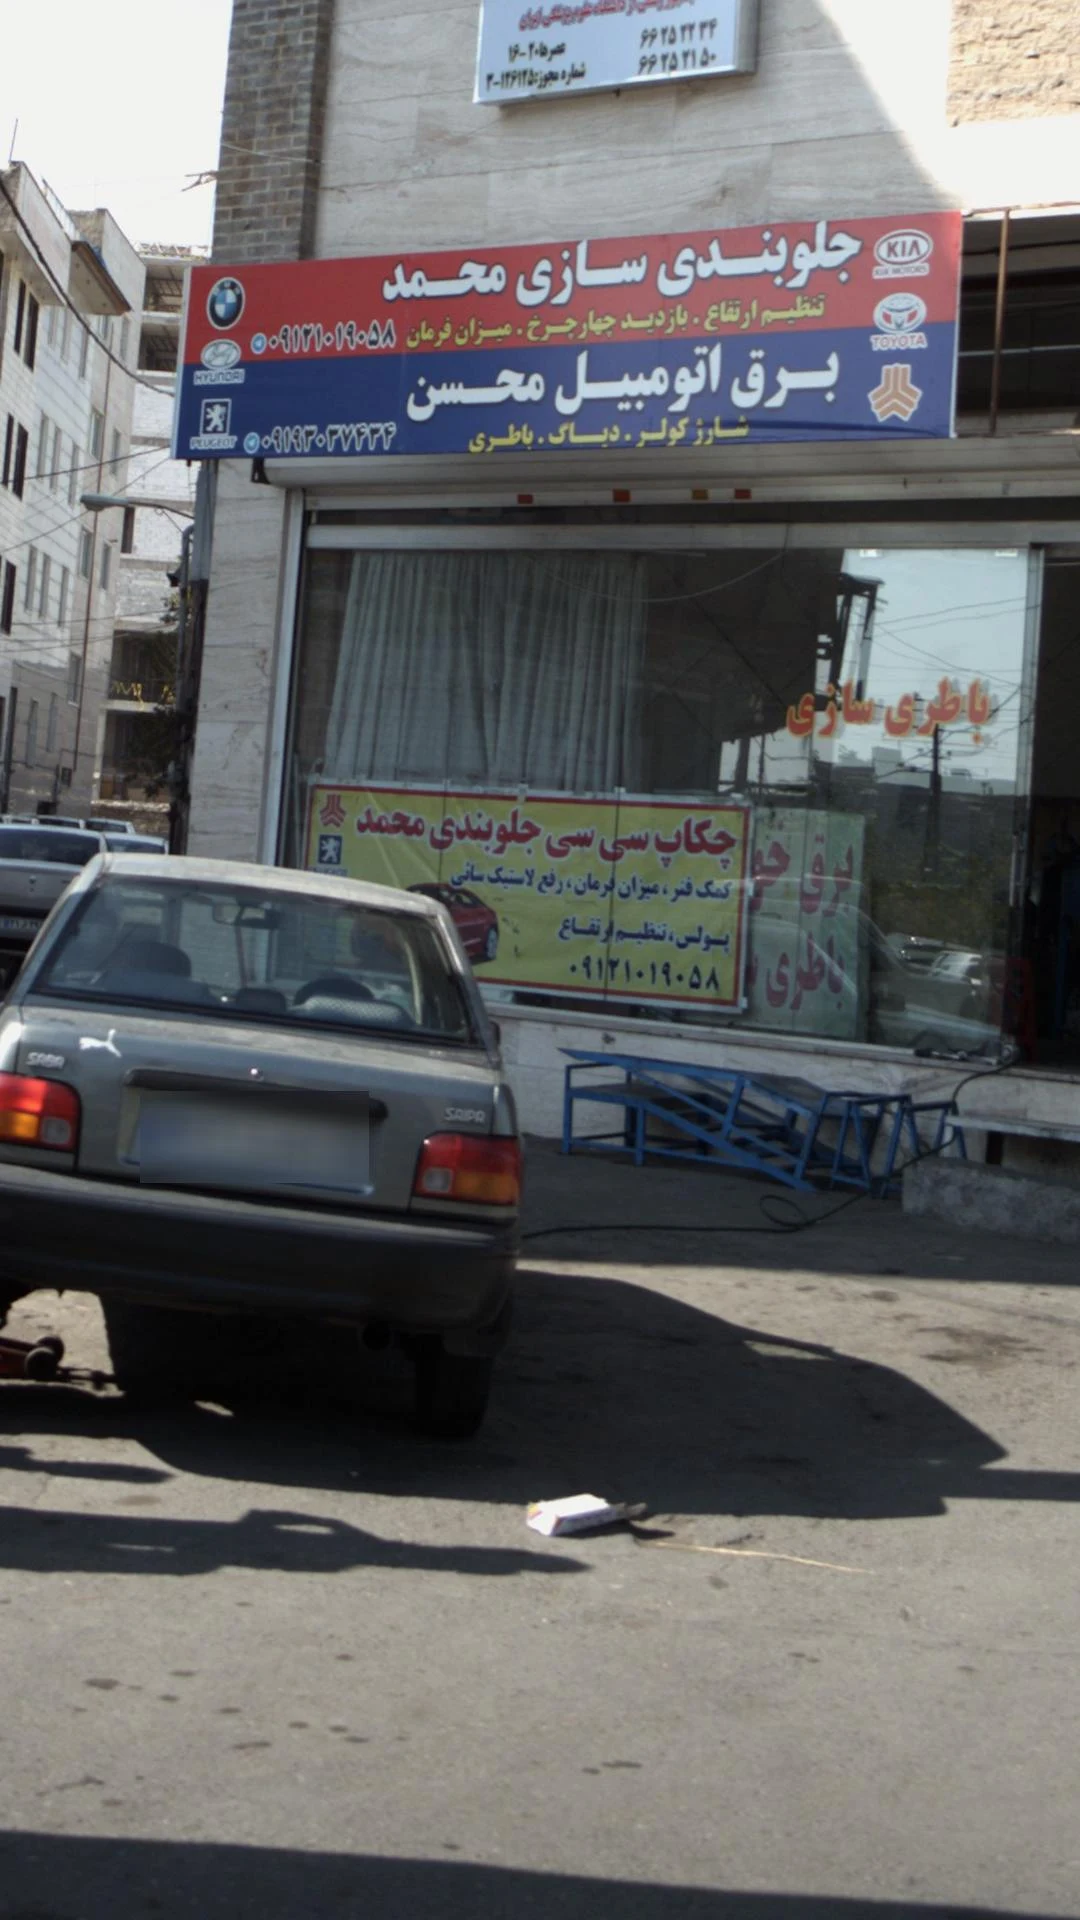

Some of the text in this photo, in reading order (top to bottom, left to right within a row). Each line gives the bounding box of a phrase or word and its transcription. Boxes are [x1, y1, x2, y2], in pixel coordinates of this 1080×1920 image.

[382, 220, 863, 307] جلوبندی سازی محمد
[885, 239, 921, 258] KIA
[620, 304, 690, 335] بازدید
[704, 299, 757, 332] ارتفاع
[761, 294, 826, 327] تنظیم
[269, 319, 397, 354] ۰۹۱۲۱۰۱۹۰۵۸
[406, 317, 452, 348] فرمان
[454, 318, 513, 346] میزان
[870, 333, 928, 351] TOYOTA
[194, 370, 245, 384] HYUNDAI
[406, 342, 840, 421] برق اتومبیل محسن
[468, 415, 749, 453] شارژ کولر دیاگ باطری
[787, 675, 991, 744] باطری سازی
[356, 807, 738, 869] چکاپ سی سی جلوبندی محمد
[487, 867, 535, 890] لاستیک
[617, 876, 660, 901] میزان
[558, 916, 614, 943] ارتفاع
[616, 921, 667, 946] تنظیم
[569, 955, 720, 991] ۰۹۱۲۱۰۱۹۰۵۸
